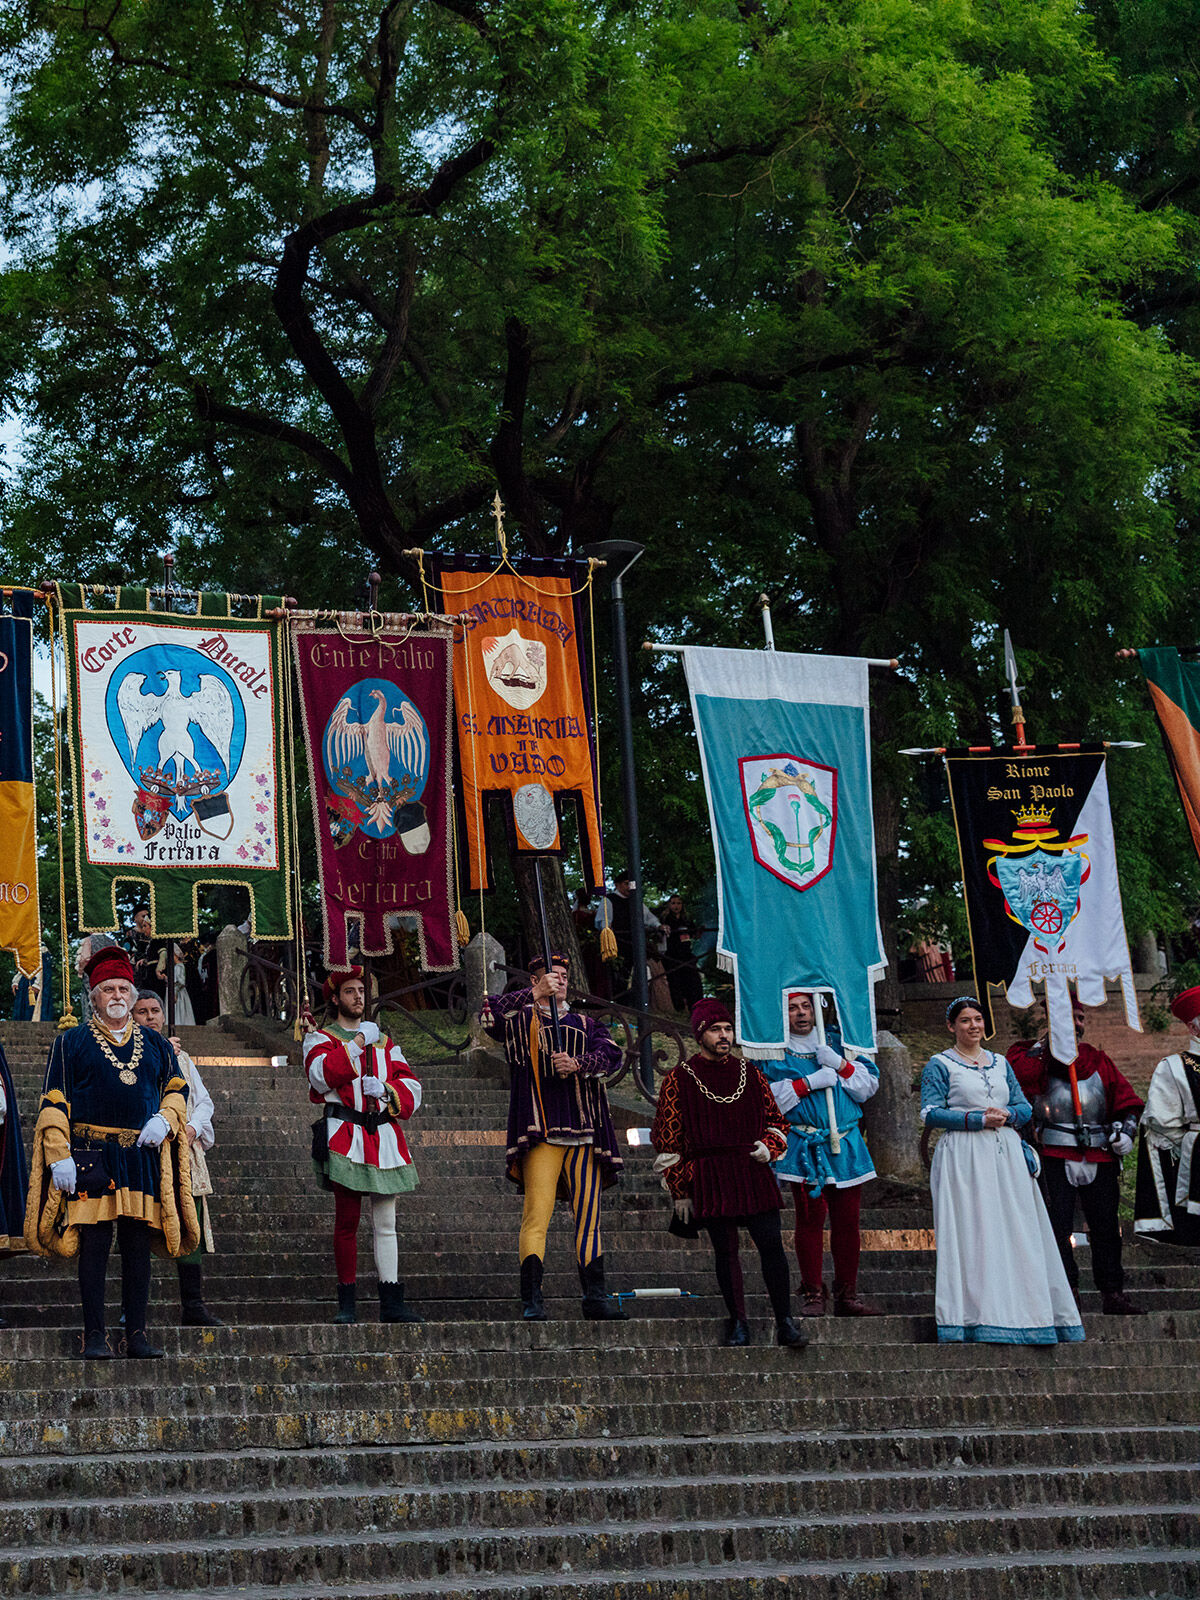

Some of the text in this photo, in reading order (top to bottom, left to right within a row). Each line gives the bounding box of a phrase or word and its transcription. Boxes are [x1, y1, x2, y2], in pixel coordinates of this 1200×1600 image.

[80, 626, 270, 700] Corte Ducale
[311, 643, 435, 670] Ente Palio
[461, 713, 584, 739] S. MARIA
[489, 752, 565, 777] VADO
[1005, 763, 1050, 779] Rione
[986, 784, 1074, 801] San Paolo
[163, 823, 201, 840] Palio
[144, 841, 220, 861] Ferrara
